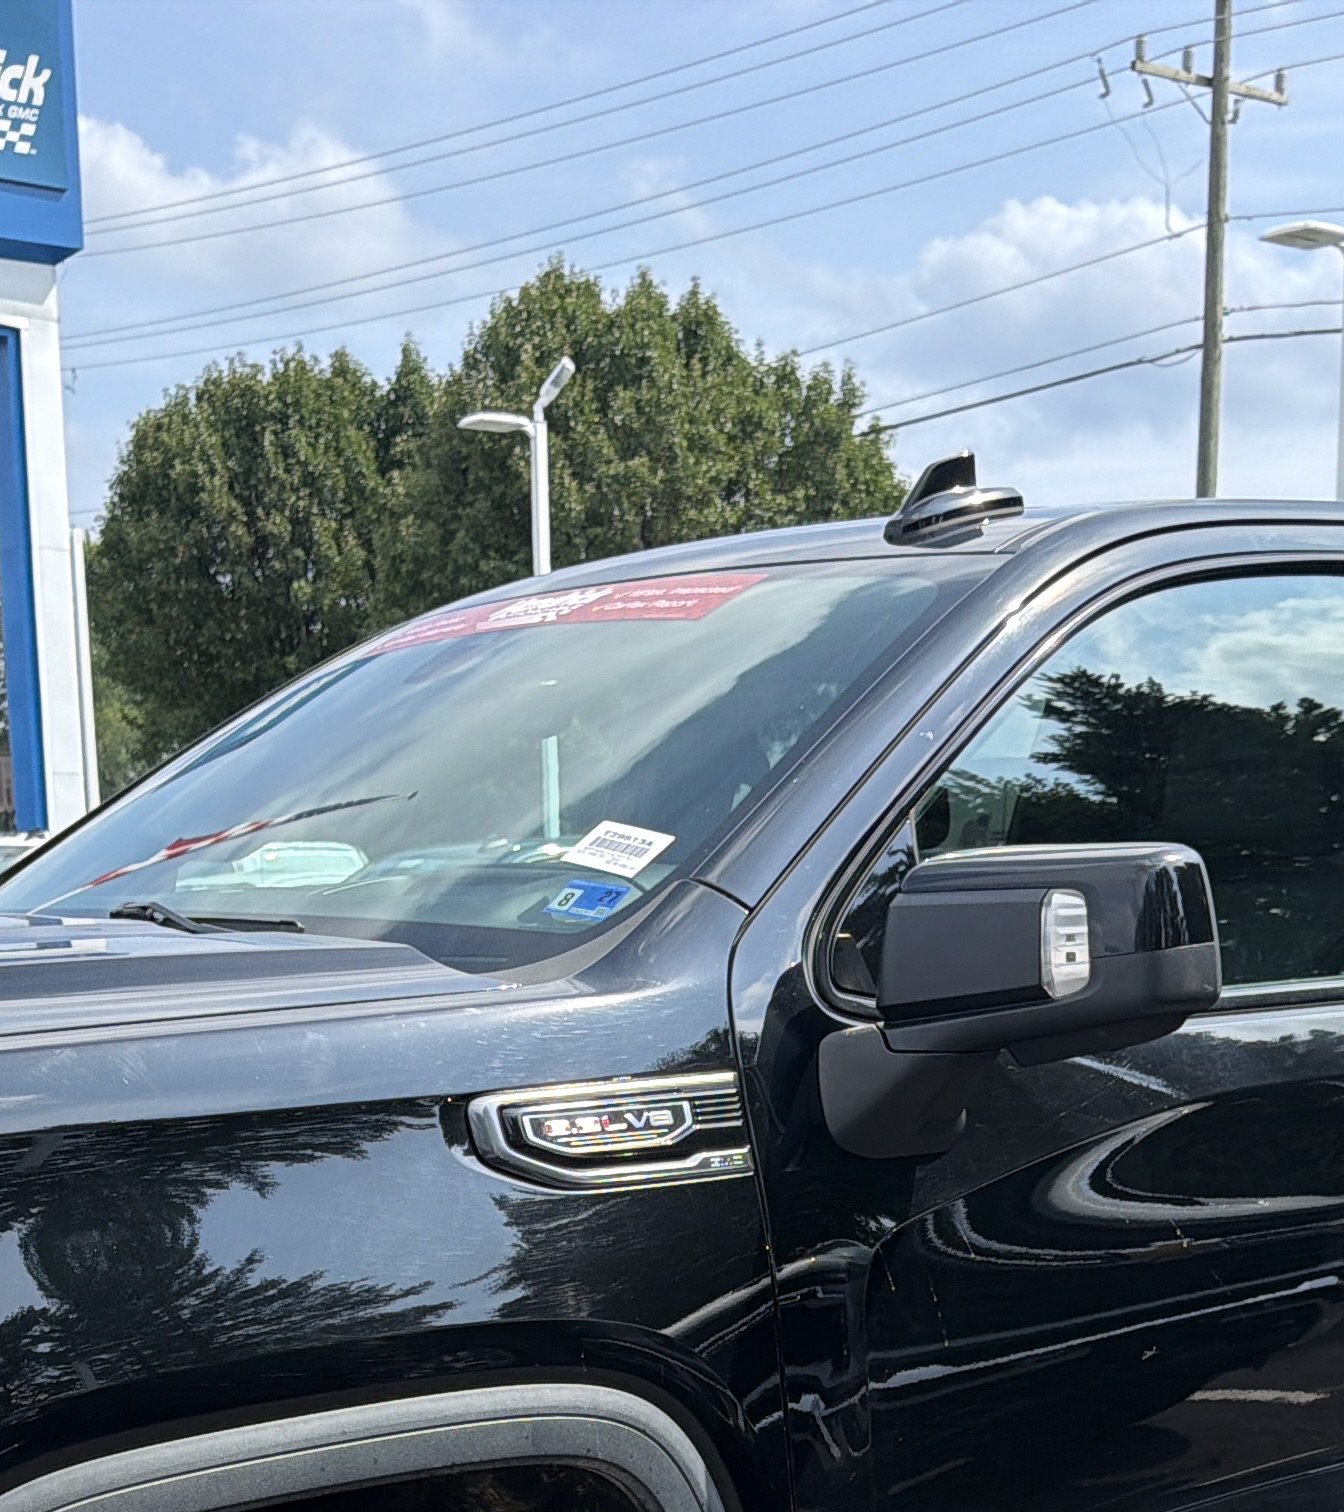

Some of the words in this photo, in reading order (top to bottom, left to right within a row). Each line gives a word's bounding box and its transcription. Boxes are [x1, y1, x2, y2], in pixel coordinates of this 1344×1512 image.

[7, 105, 39, 122] GMC
[557, 892, 576, 907] 8
[623, 1110, 674, 1129] V8
